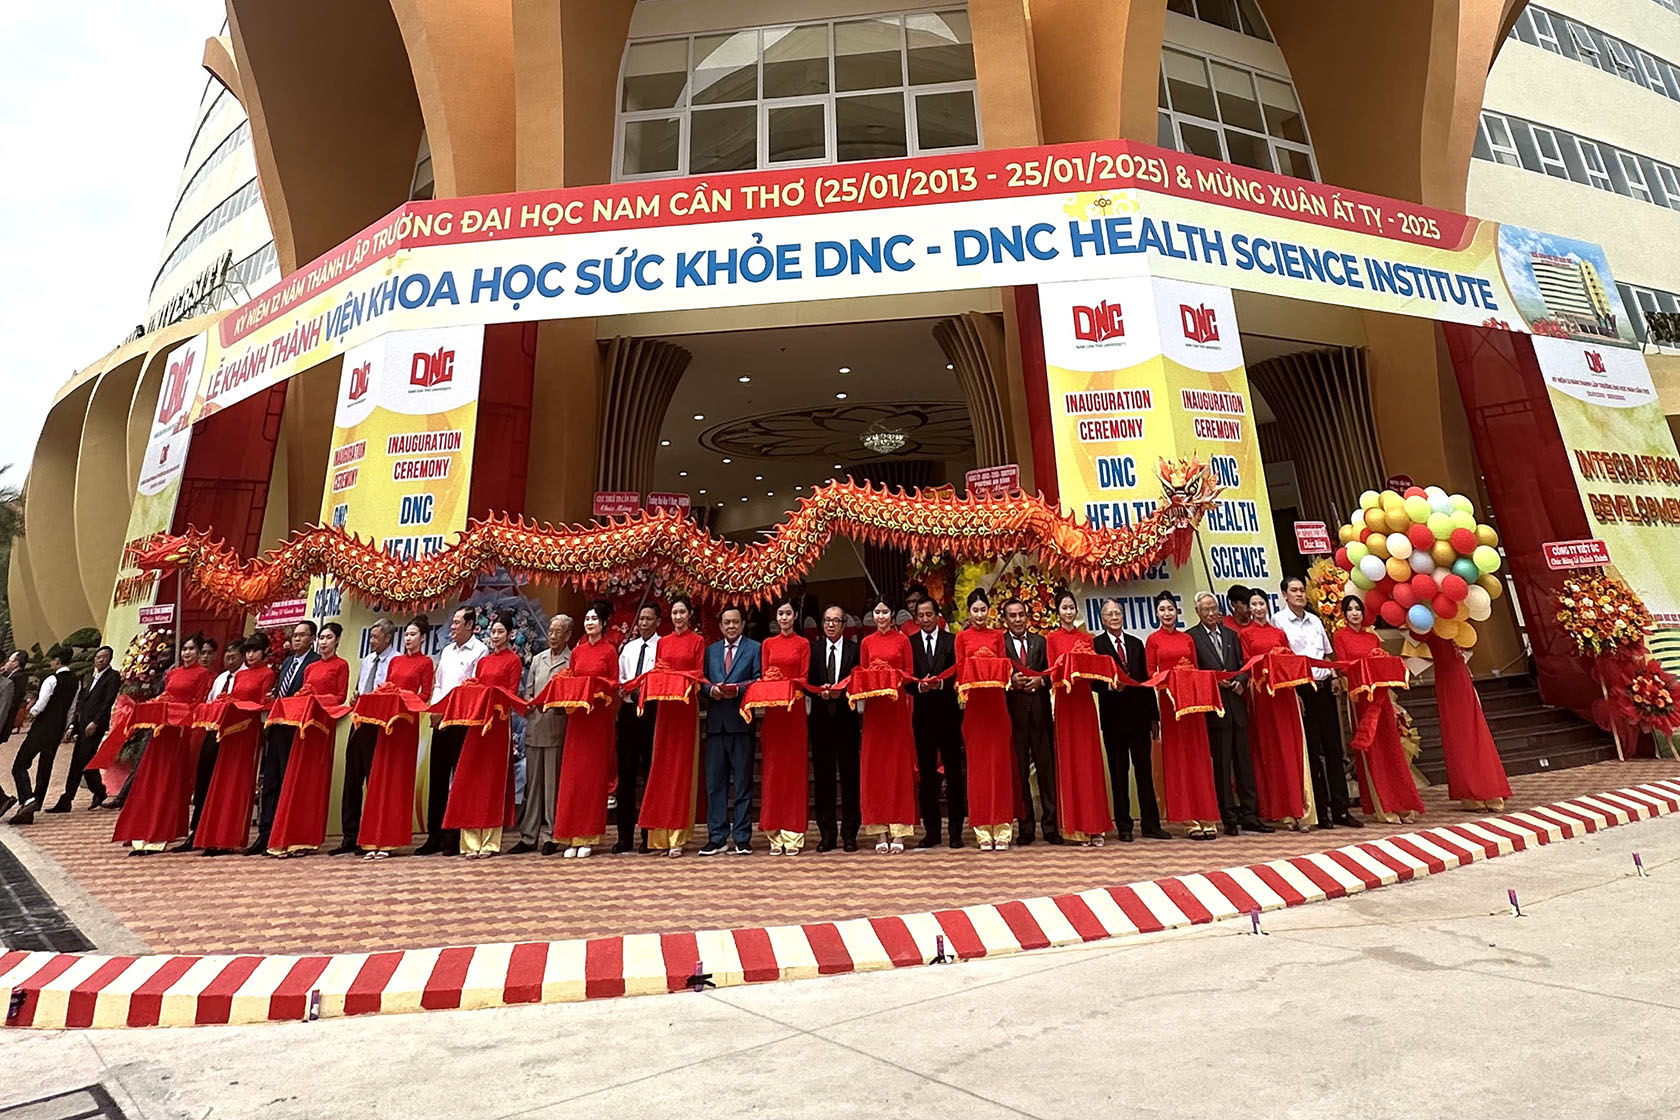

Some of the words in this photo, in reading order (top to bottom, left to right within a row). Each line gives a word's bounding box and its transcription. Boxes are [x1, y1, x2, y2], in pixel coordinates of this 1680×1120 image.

[307, 258, 343, 295] THÀNH
[345, 238, 370, 272] LẬP
[372, 212, 454, 255] TRƯỜNG
[460, 206, 511, 238] ĐẠI
[520, 200, 583, 233] HỌC
[592, 195, 660, 222] NAM
[669, 183, 732, 216] CẦN
[741, 178, 805, 208] THƠ
[815, 167, 978, 207] (25/01/2013
[1007, 151, 1169, 190] 25/01/2025)
[1176, 165, 1192, 189] &
[1197, 166, 1264, 205] MỪNG
[1270, 184, 1328, 218] XUÂN
[1332, 191, 1356, 221] ẤT
[1358, 203, 1385, 234] TỴ
[1401, 212, 1441, 240] 2025
[221, 346, 269, 395] KHÁNH
[270, 317, 323, 368] THÀNH
[325, 291, 365, 344] VIỆN
[366, 271, 459, 321] KHOA
[470, 261, 565, 311] HỌC
[574, 246, 664, 296] SỨC
[676, 232, 801, 288] KHỎE
[815, 234, 917, 278] DNC
[954, 221, 1059, 267] DNC
[1069, 216, 1227, 266] HEALTH
[1231, 234, 1363, 288] SCIENCE
[1364, 257, 1498, 312] INSTITUTE
[1072, 299, 1125, 342] DNC
[1179, 303, 1220, 343] DNC
[349, 360, 371, 400] DNC
[410, 346, 455, 387] DNC
[158, 347, 196, 425] DNC
[1065, 389, 1151, 413] INAUGURATION
[1182, 390, 1244, 413] INAUGURATION
[388, 432, 461, 454] INAUGURATION
[1080, 418, 1143, 440] CEREMONY
[1194, 418, 1241, 440] CEREMONY
[394, 458, 449, 480] CEREMONY
[1098, 457, 1136, 488] DNC
[1211, 457, 1239, 487] DNC
[1574, 449, 1680, 485] INTEGRATION
[400, 495, 433, 524] DNC
[1207, 502, 1258, 532] HEALTH
[1211, 547, 1268, 578] SCIENCE
[1086, 594, 1185, 631] INTITUE
